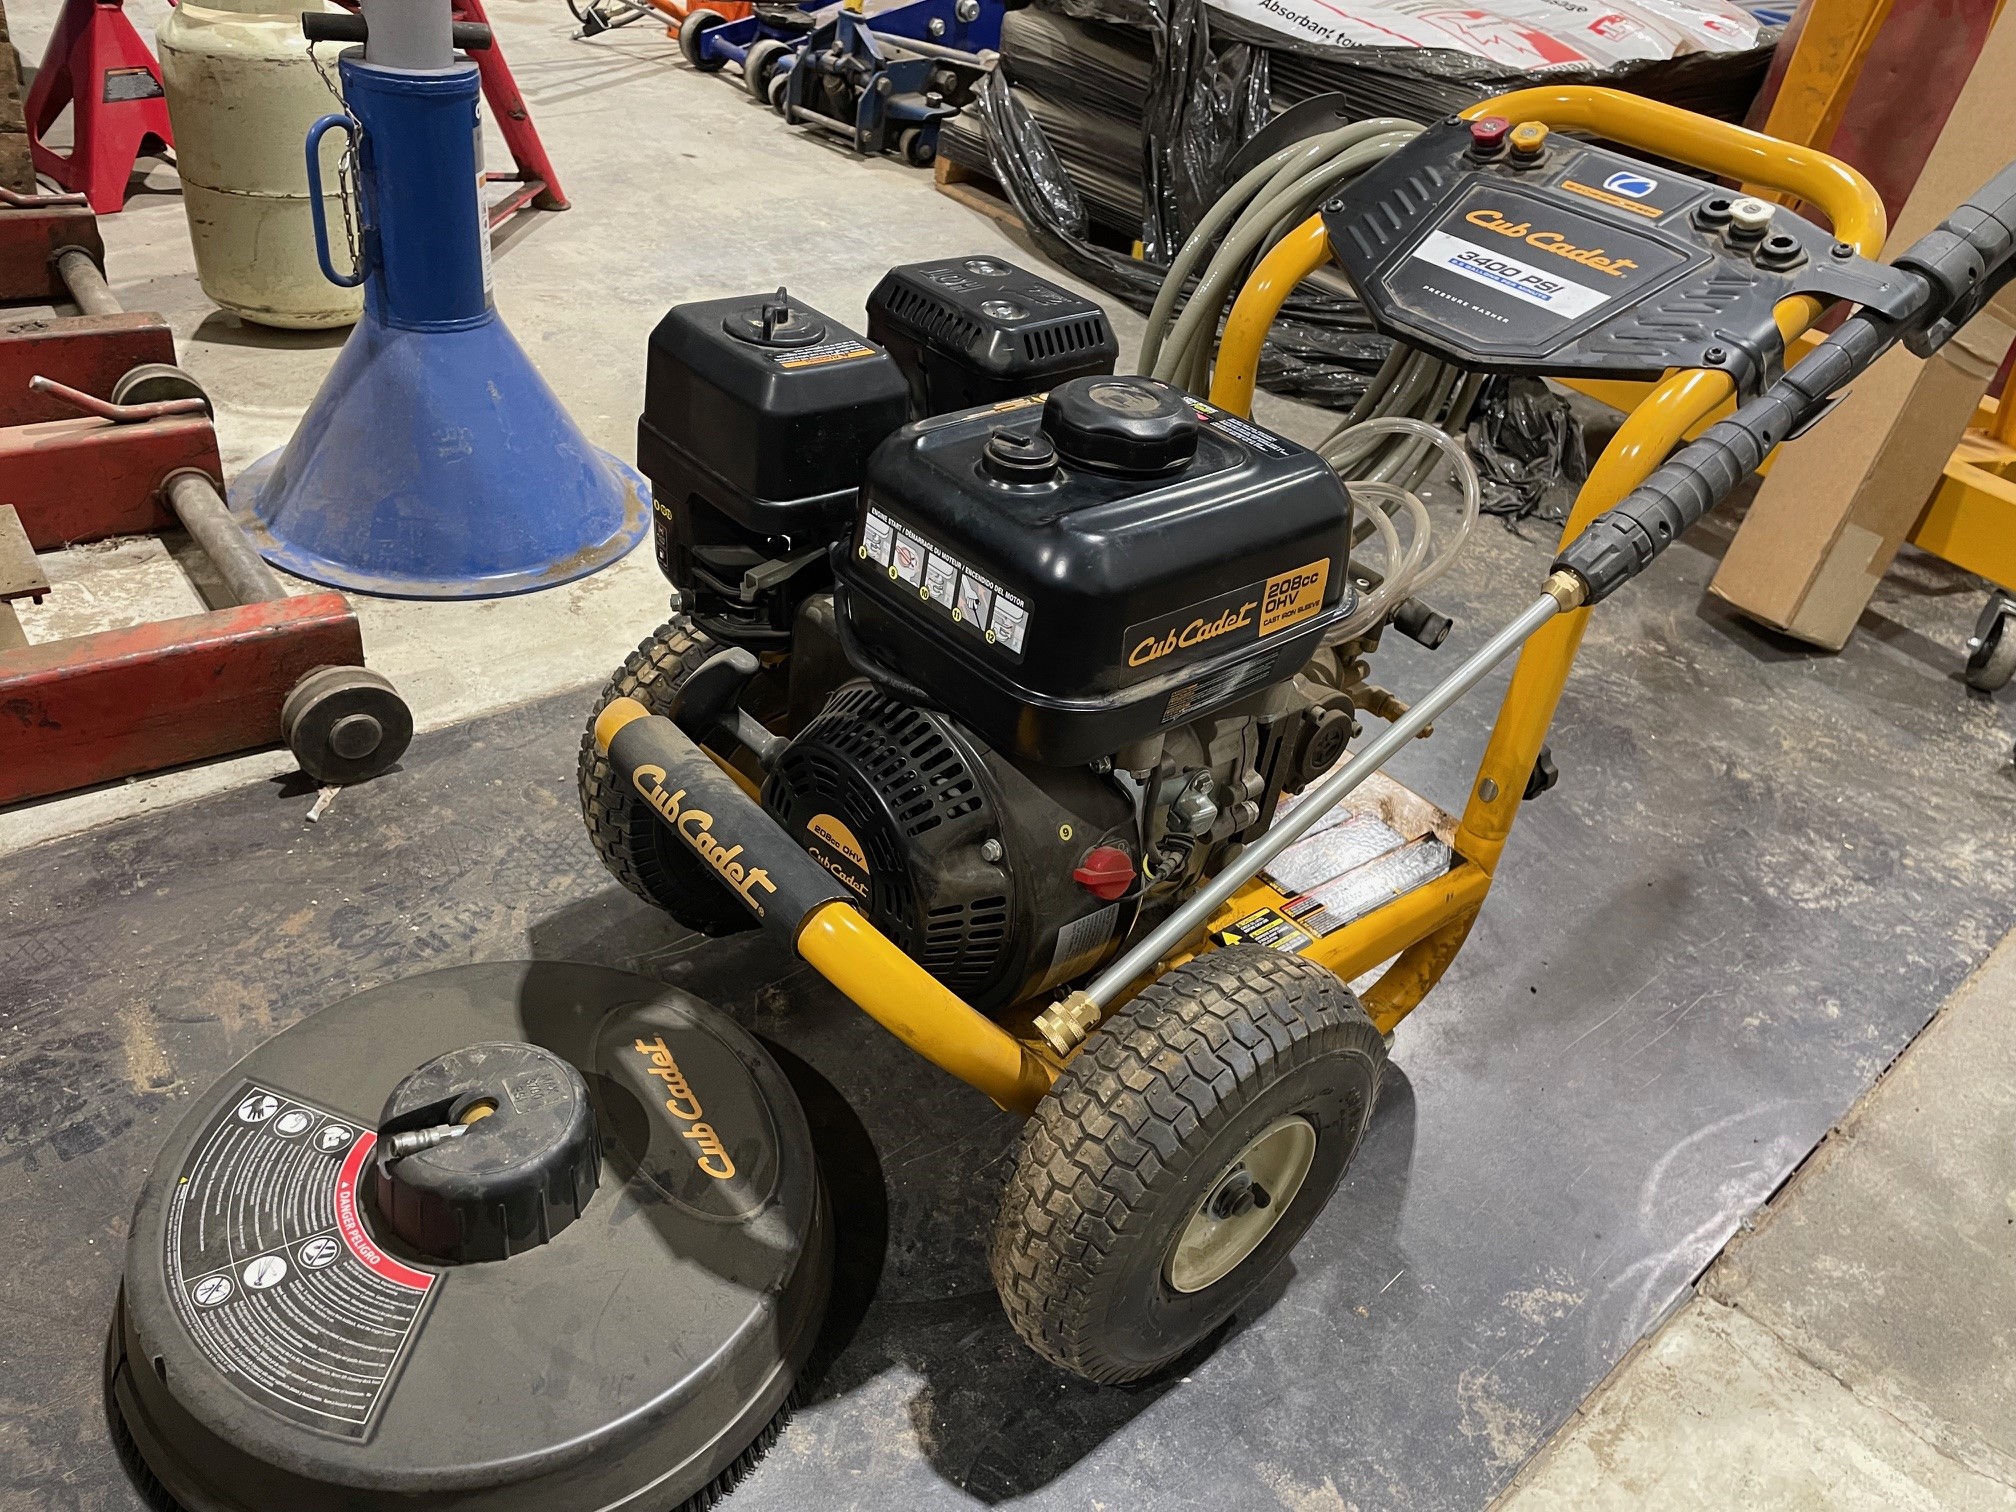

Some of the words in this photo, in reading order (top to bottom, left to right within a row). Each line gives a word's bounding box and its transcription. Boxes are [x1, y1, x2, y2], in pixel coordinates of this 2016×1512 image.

[1259, 0, 1336, 39] Absorbant
[1465, 209, 1532, 238] Cub
[1525, 231, 1639, 277] Cadet
[1457, 250, 1522, 278] 3400
[1519, 275, 1566, 294] PSI
[1465, 263, 1501, 283] GALLONS
[1499, 277, 1518, 290] PER
[1517, 283, 1550, 300] MINUTE
[1422, 285, 1470, 307] PRESSURE
[1471, 304, 1509, 324] WASHER
[871, 506, 889, 524] ENGINE
[888, 518, 903, 533] START
[934, 546, 942, 557] DU
[941, 549, 962, 570] MOTEUR
[964, 567, 995, 590] ENCENDIDO
[993, 583, 1006, 597] DEL
[1004, 588, 1025, 608] MOTOR
[1264, 591, 1300, 614] OHV
[1267, 572, 1319, 600] 208cc
[1128, 628, 1178, 667] Cub
[1178, 601, 1259, 649] Cadet
[1263, 614, 1281, 627] CAST
[1281, 608, 1297, 622] IRON
[1297, 599, 1321, 614] SLEEVE
[632, 764, 687, 824] Cub
[677, 809, 778, 910] Cadet
[814, 824, 841, 849] 208cc
[842, 845, 863, 863] OHV
[808, 846, 831, 870] Cub
[830, 863, 869, 898] Cadet
[634, 1037, 703, 1121] Cadet
[682, 1122, 736, 1179] Cub
[339, 1191, 356, 1232] DANGER
[348, 1228, 381, 1265] PELIGRO
